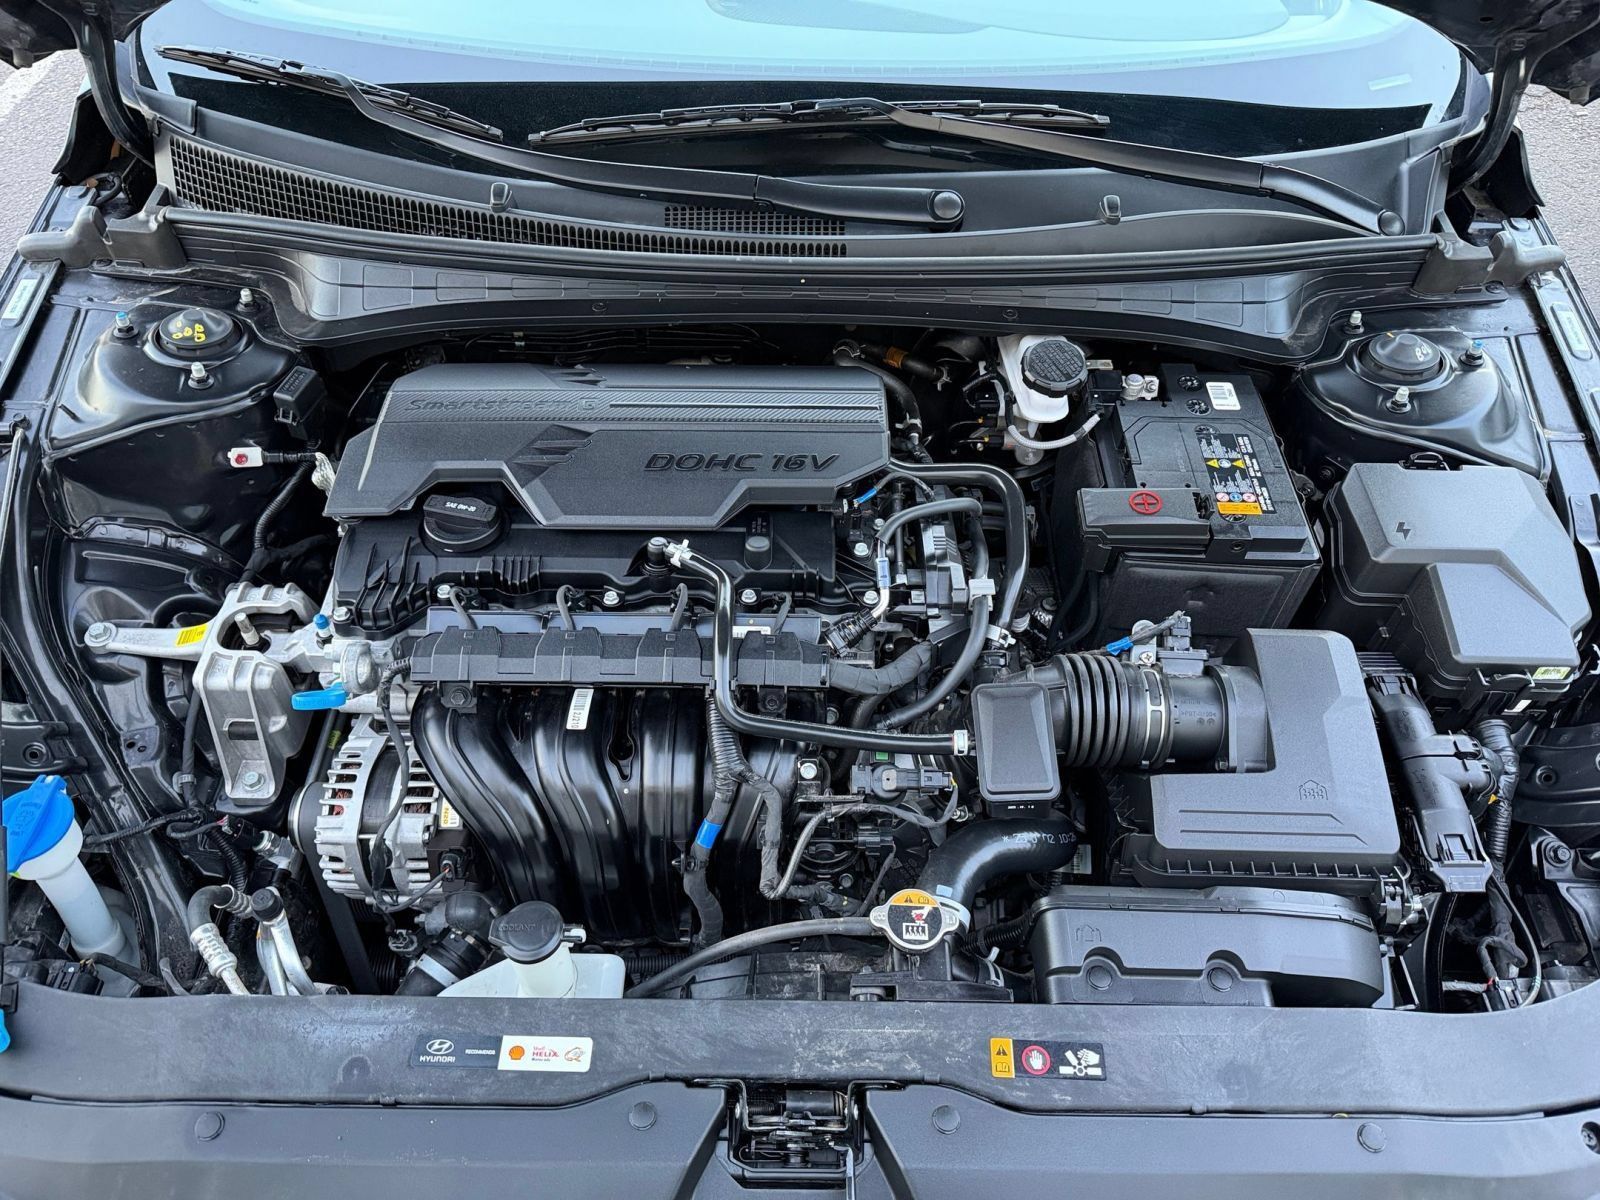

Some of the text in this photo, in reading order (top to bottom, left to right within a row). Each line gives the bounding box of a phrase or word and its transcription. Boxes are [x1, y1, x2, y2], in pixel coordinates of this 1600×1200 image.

[644, 453, 840, 472] DOHC 16V
[532, 1050, 559, 1058] HELIX
[420, 1055, 456, 1063] HYUNDAI
